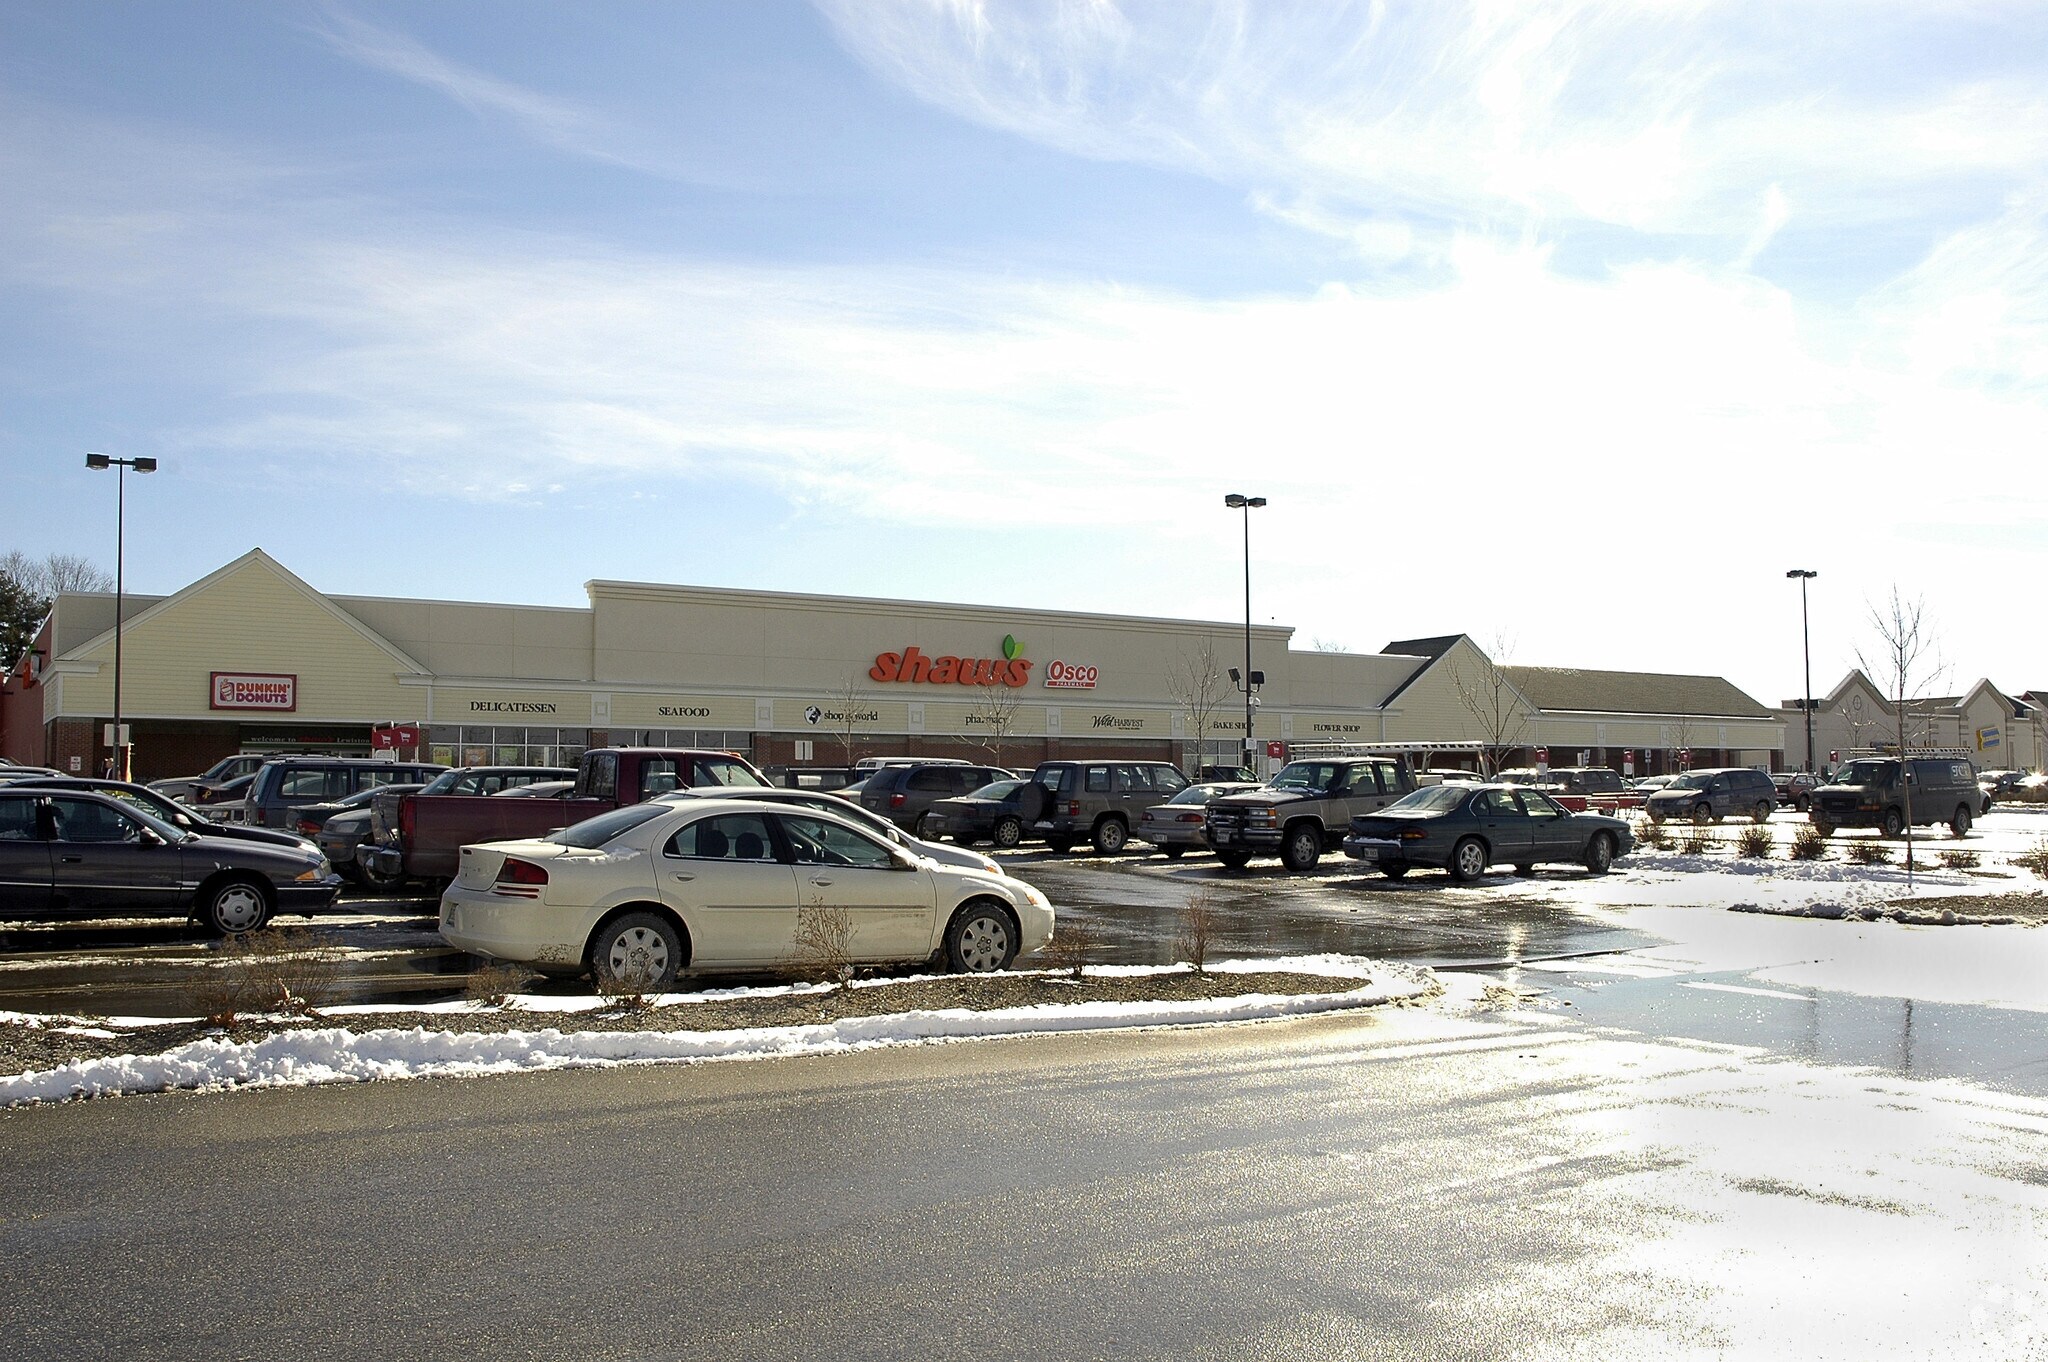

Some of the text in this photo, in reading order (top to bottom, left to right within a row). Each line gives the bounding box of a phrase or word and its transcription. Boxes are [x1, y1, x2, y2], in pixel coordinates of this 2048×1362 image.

[235, 682, 291, 693] DUNKIN'
[235, 692, 288, 704] DONUTS
[470, 701, 557, 713] DELICATESSEN
[658, 706, 710, 717] SEAFOOD
[824, 710, 844, 722] shop
[855, 711, 878, 720] world
[1091, 714, 1145, 728] Wild HARVEST
[1213, 720, 1255, 730] BAKE SHP
[1313, 723, 1361, 733] FLOWER SHOP
